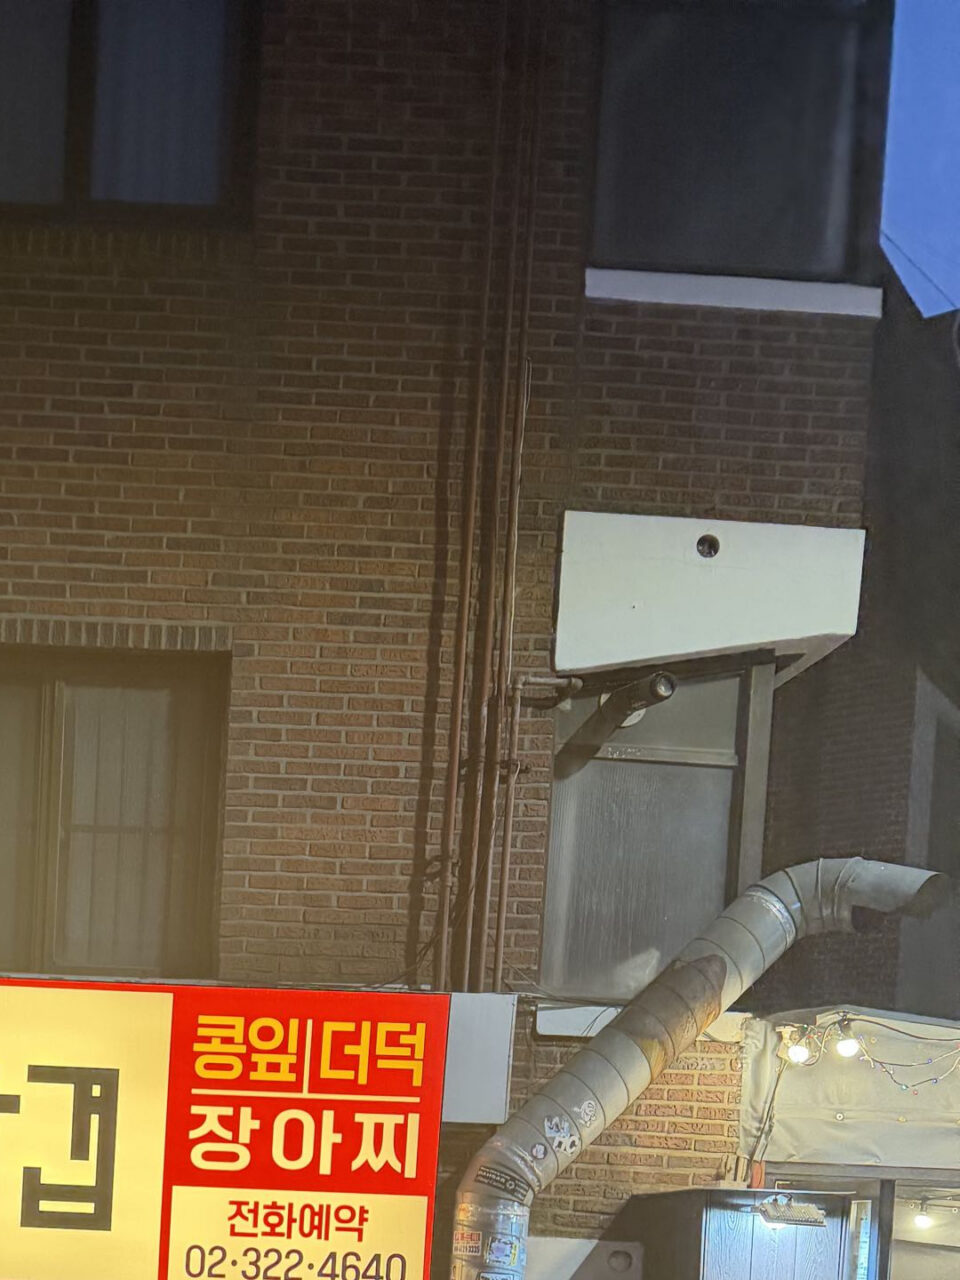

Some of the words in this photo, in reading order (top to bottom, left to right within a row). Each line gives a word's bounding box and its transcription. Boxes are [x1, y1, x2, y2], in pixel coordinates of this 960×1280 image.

[193, 1014, 299, 1082] 콩잎
[319, 1020, 426, 1087] 더덕
[188, 1104, 420, 1179] 장아찌
[227, 1200, 369, 1243] 전화예약
